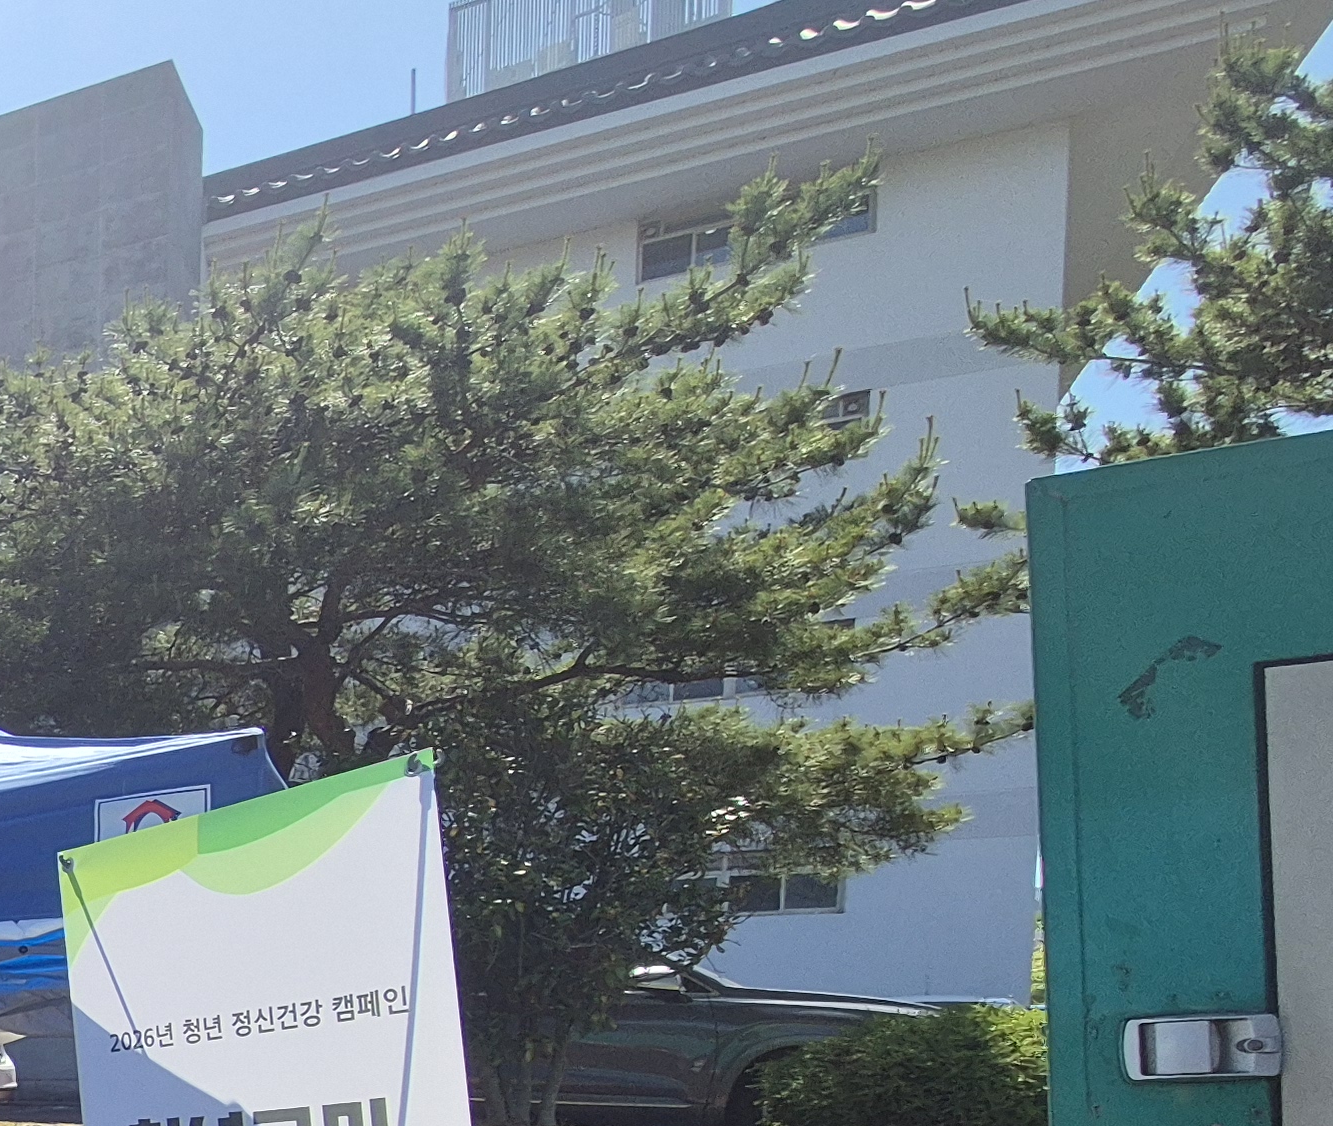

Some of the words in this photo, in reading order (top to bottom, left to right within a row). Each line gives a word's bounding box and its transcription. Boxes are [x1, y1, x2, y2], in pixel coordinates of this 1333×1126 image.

[109, 1022, 174, 1053] 2026년
[182, 1014, 223, 1046] 청년
[231, 999, 323, 1038] 정신건강
[331, 985, 410, 1023] 캠페인
